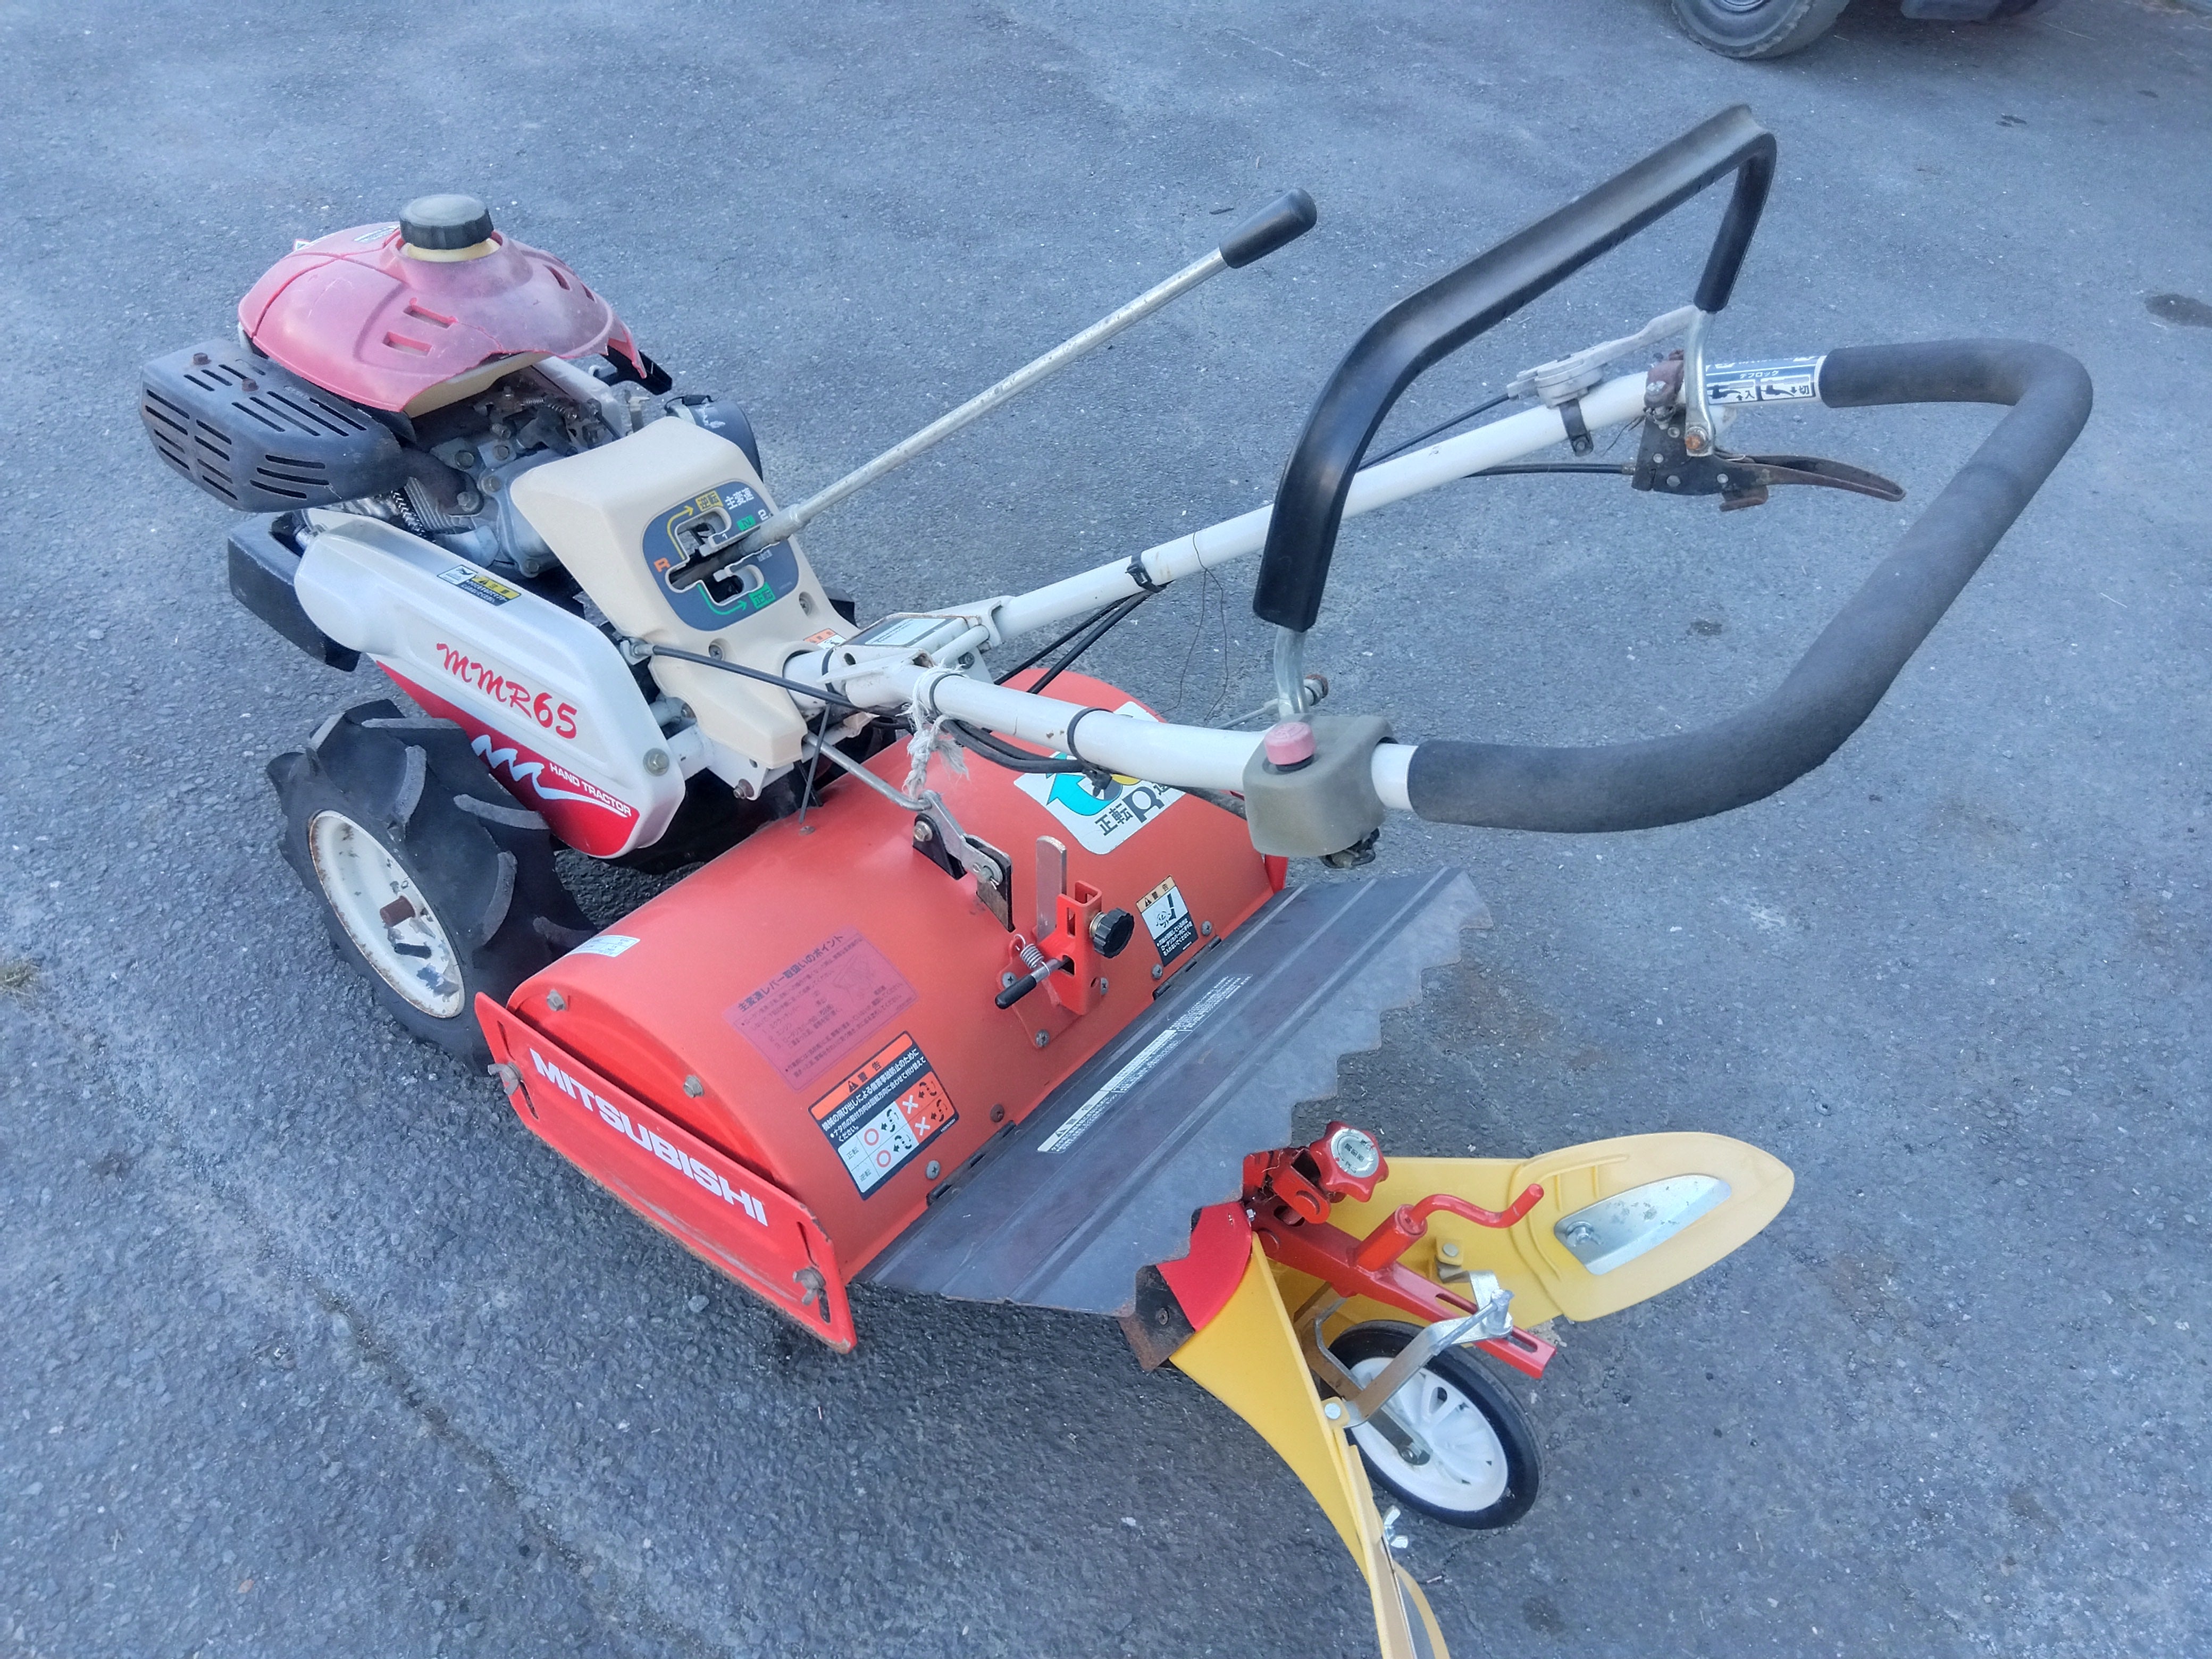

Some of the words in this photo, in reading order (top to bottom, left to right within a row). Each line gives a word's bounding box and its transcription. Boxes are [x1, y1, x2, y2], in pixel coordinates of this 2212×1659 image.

[1739, 370, 1779, 379] デフロック
[1745, 390, 1755, 399] 入
[1799, 386, 1809, 395] 切
[699, 492, 720, 509] 逆転
[725, 487, 755, 510] 主変速
[743, 518, 753, 527] N
[758, 509, 769, 521] 2
[653, 557, 671, 572] R
[753, 589, 774, 605] 正転
[436, 642, 578, 740] MMR65
[549, 762, 580, 787] HAND
[581, 780, 632, 817] TRACTOR
[529, 1047, 768, 1227] MITSUBISHI
